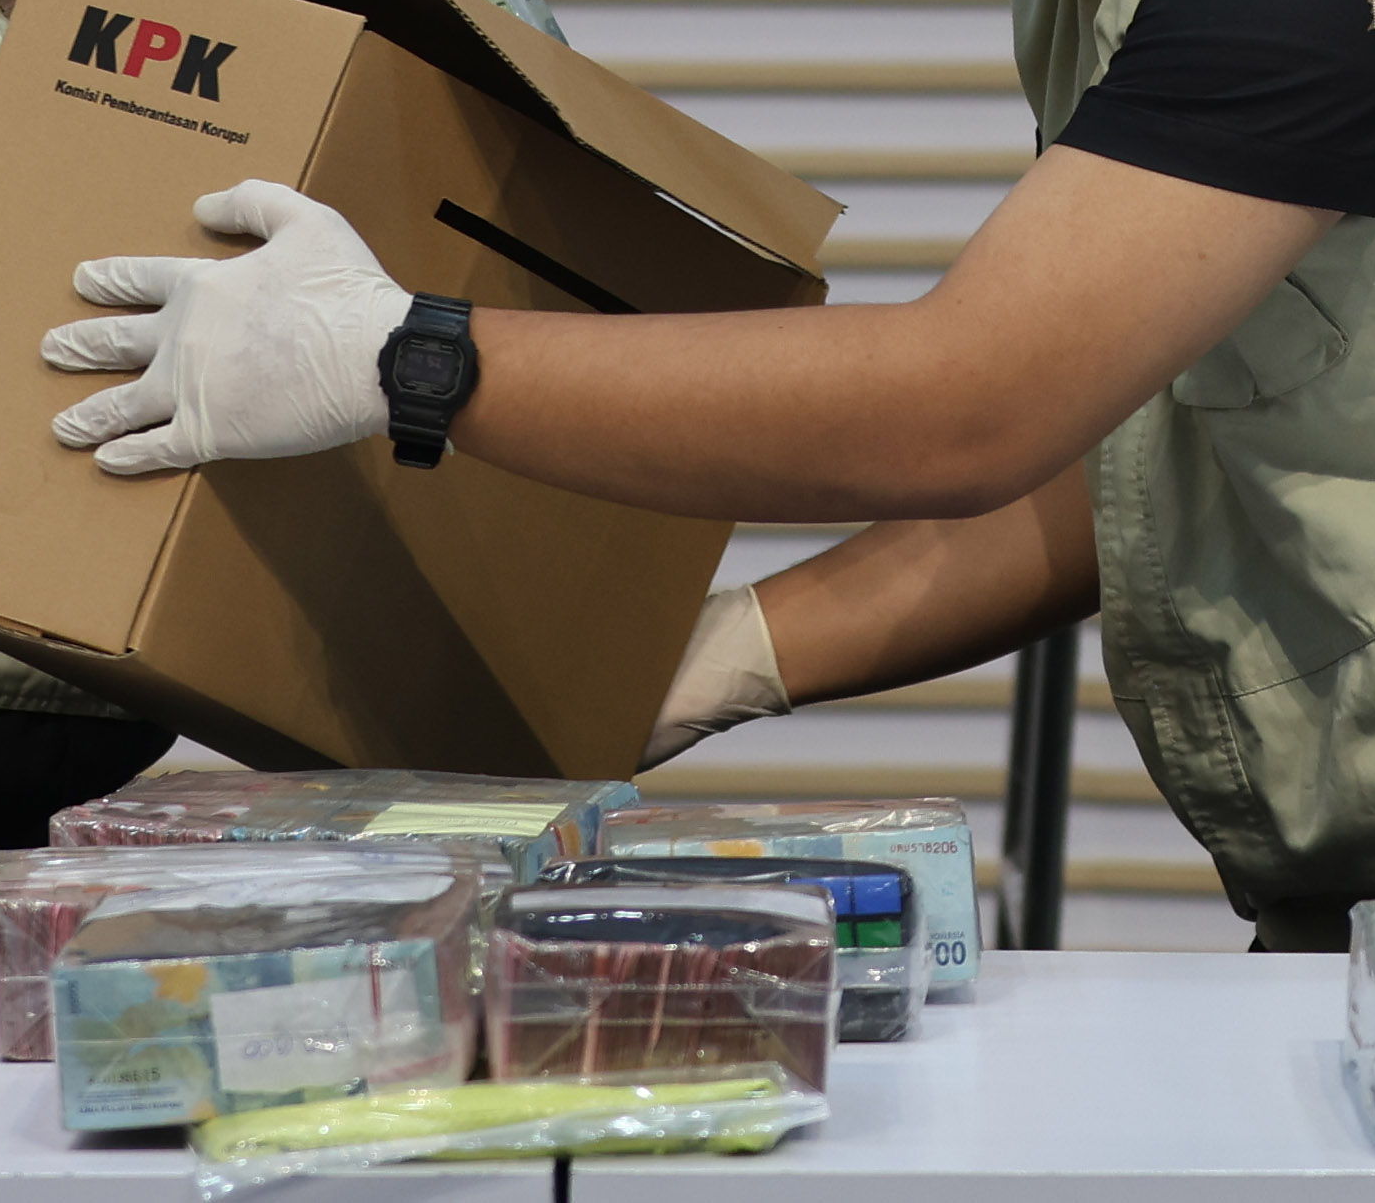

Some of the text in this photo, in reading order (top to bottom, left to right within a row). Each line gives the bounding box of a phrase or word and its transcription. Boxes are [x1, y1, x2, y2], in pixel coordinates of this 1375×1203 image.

[68, 5, 238, 102] KPK
[55, 79, 251, 145] Komisi Pemberantasan Korupsi
